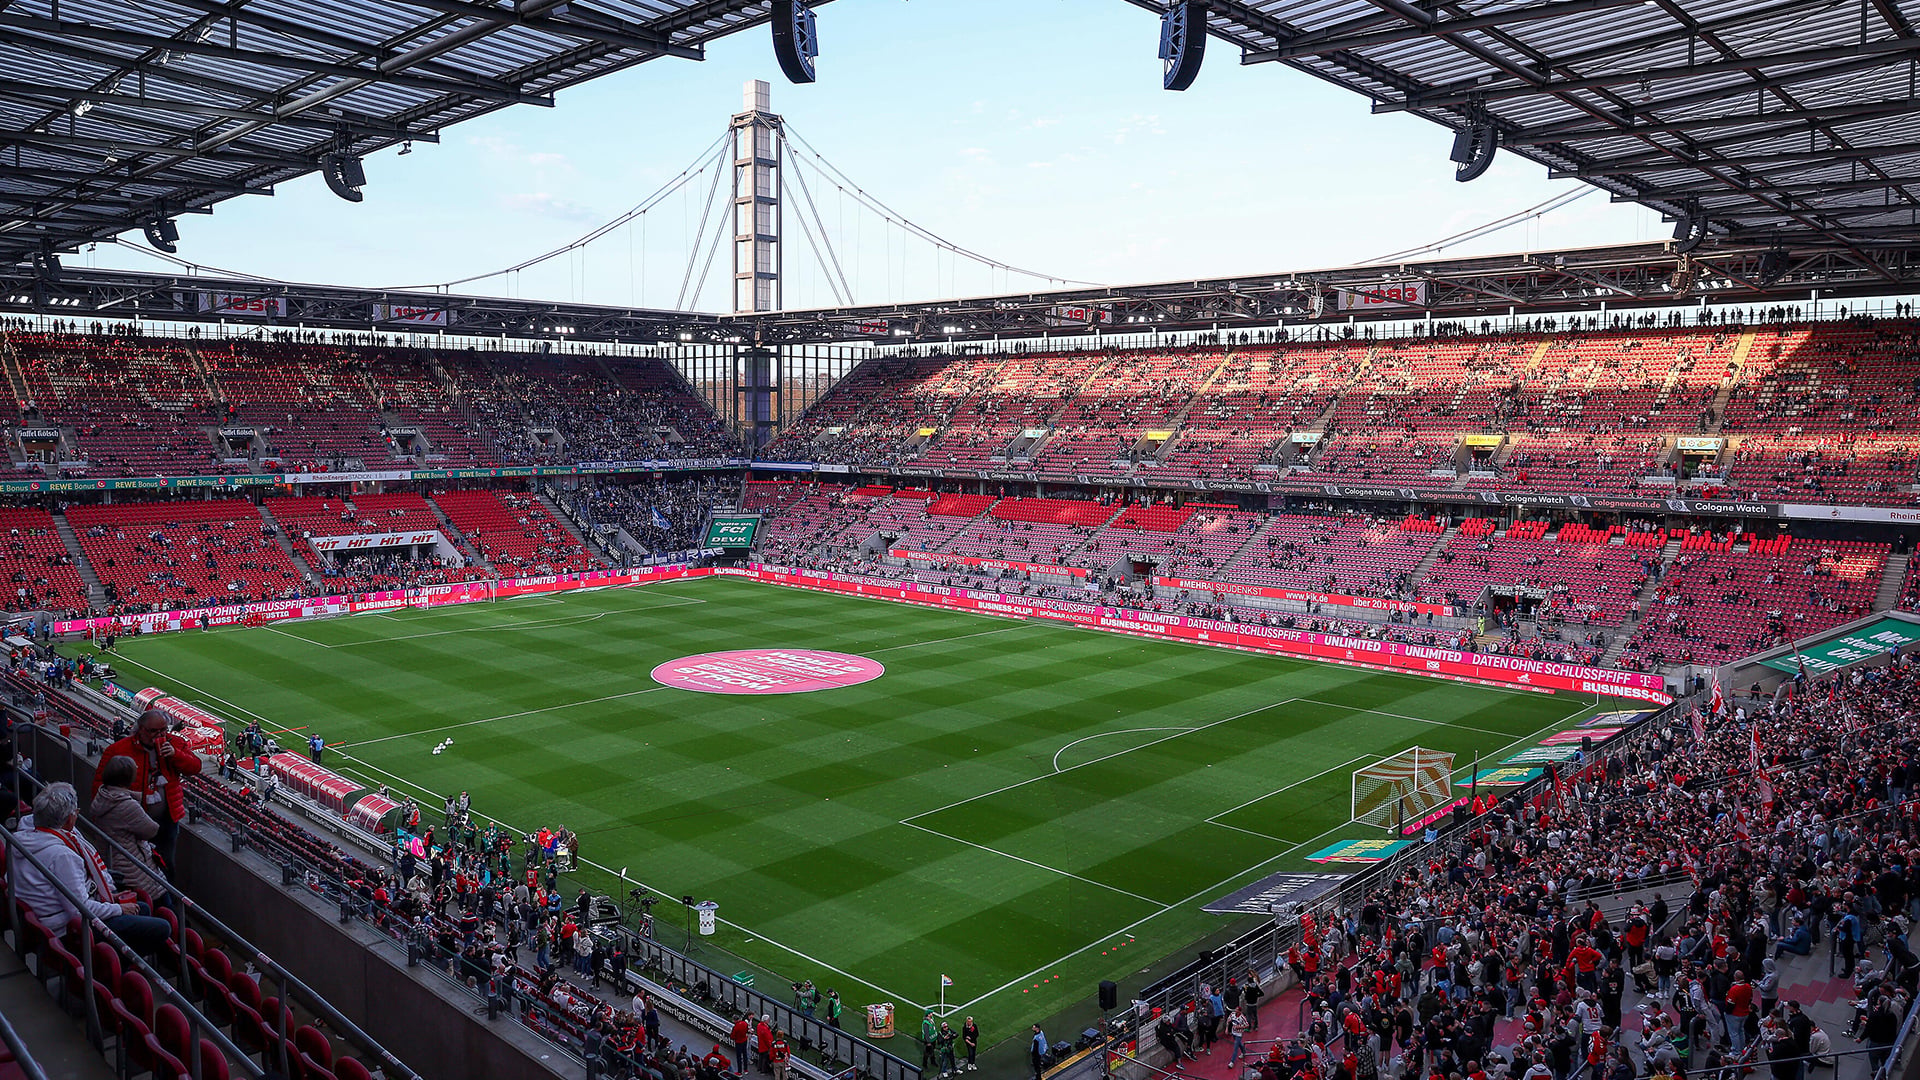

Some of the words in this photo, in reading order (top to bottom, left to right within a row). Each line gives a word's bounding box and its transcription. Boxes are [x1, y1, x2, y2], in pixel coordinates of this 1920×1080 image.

[75, 482, 95, 490] Bonus
[139, 480, 158, 488] Bonus
[199, 478, 217, 486] Bonus
[235, 478, 251, 486] REWE
[1092, 477, 1114, 485] Cologne
[1209, 482, 1233, 490] Cologne
[1273, 485, 1320, 494] colognewatch.de
[1344, 487, 1372, 497] Cologne
[1373, 488, 1395, 496] Watch
[1420, 491, 1476, 501] colognewatch.de
[1504, 494, 1537, 504] Cologne
[1538, 495, 1564, 504] Watch
[1594, 499, 1661, 509] colognewatch.de
[1695, 503, 1735, 514] Cologne
[1735, 504, 1767, 514] Watch
[719, 526, 747, 534] FC!
[714, 568, 759, 579] BUSINESS-CLUB
[762, 564, 789, 574] UNLIMITED
[802, 568, 829, 580] UNLIMITED
[515, 576, 556, 587] UNLIMITED
[967, 590, 1001, 603] UNLIMITED
[1180, 579, 1263, 596] #MEHRALSDUDENKST
[1286, 590, 1329, 604] www.kik.de
[1353, 598, 1371, 608] über
[978, 600, 1033, 615] BUSINESS-CLUB
[1006, 595, 1028, 607] DATEN
[1028, 598, 1047, 609] OHNE
[1047, 600, 1096, 615] SCHLUSSPFIFF
[180, 608, 212, 620] DATEN
[214, 605, 242, 617] OHNE
[1138, 612, 1181, 626] UNLIMITED
[1100, 617, 1165, 634] BUSINESS-CLUB
[1187, 617, 1214, 630] DATEN
[1215, 620, 1238, 634] OHNE
[1239, 624, 1302, 641] SCHLUSSPFIFF
[1324, 636, 1382, 652] UNLIMITED
[1405, 646, 1463, 662] UNLIMITED
[1472, 654, 1508, 669] DATEN
[1510, 659, 1543, 674] OHNE
[1544, 663, 1631, 685] SCHLUSSPFIFF
[650, 994, 686, 1021] Hochwertige
[1587, 1007, 1599, 1020] 13
